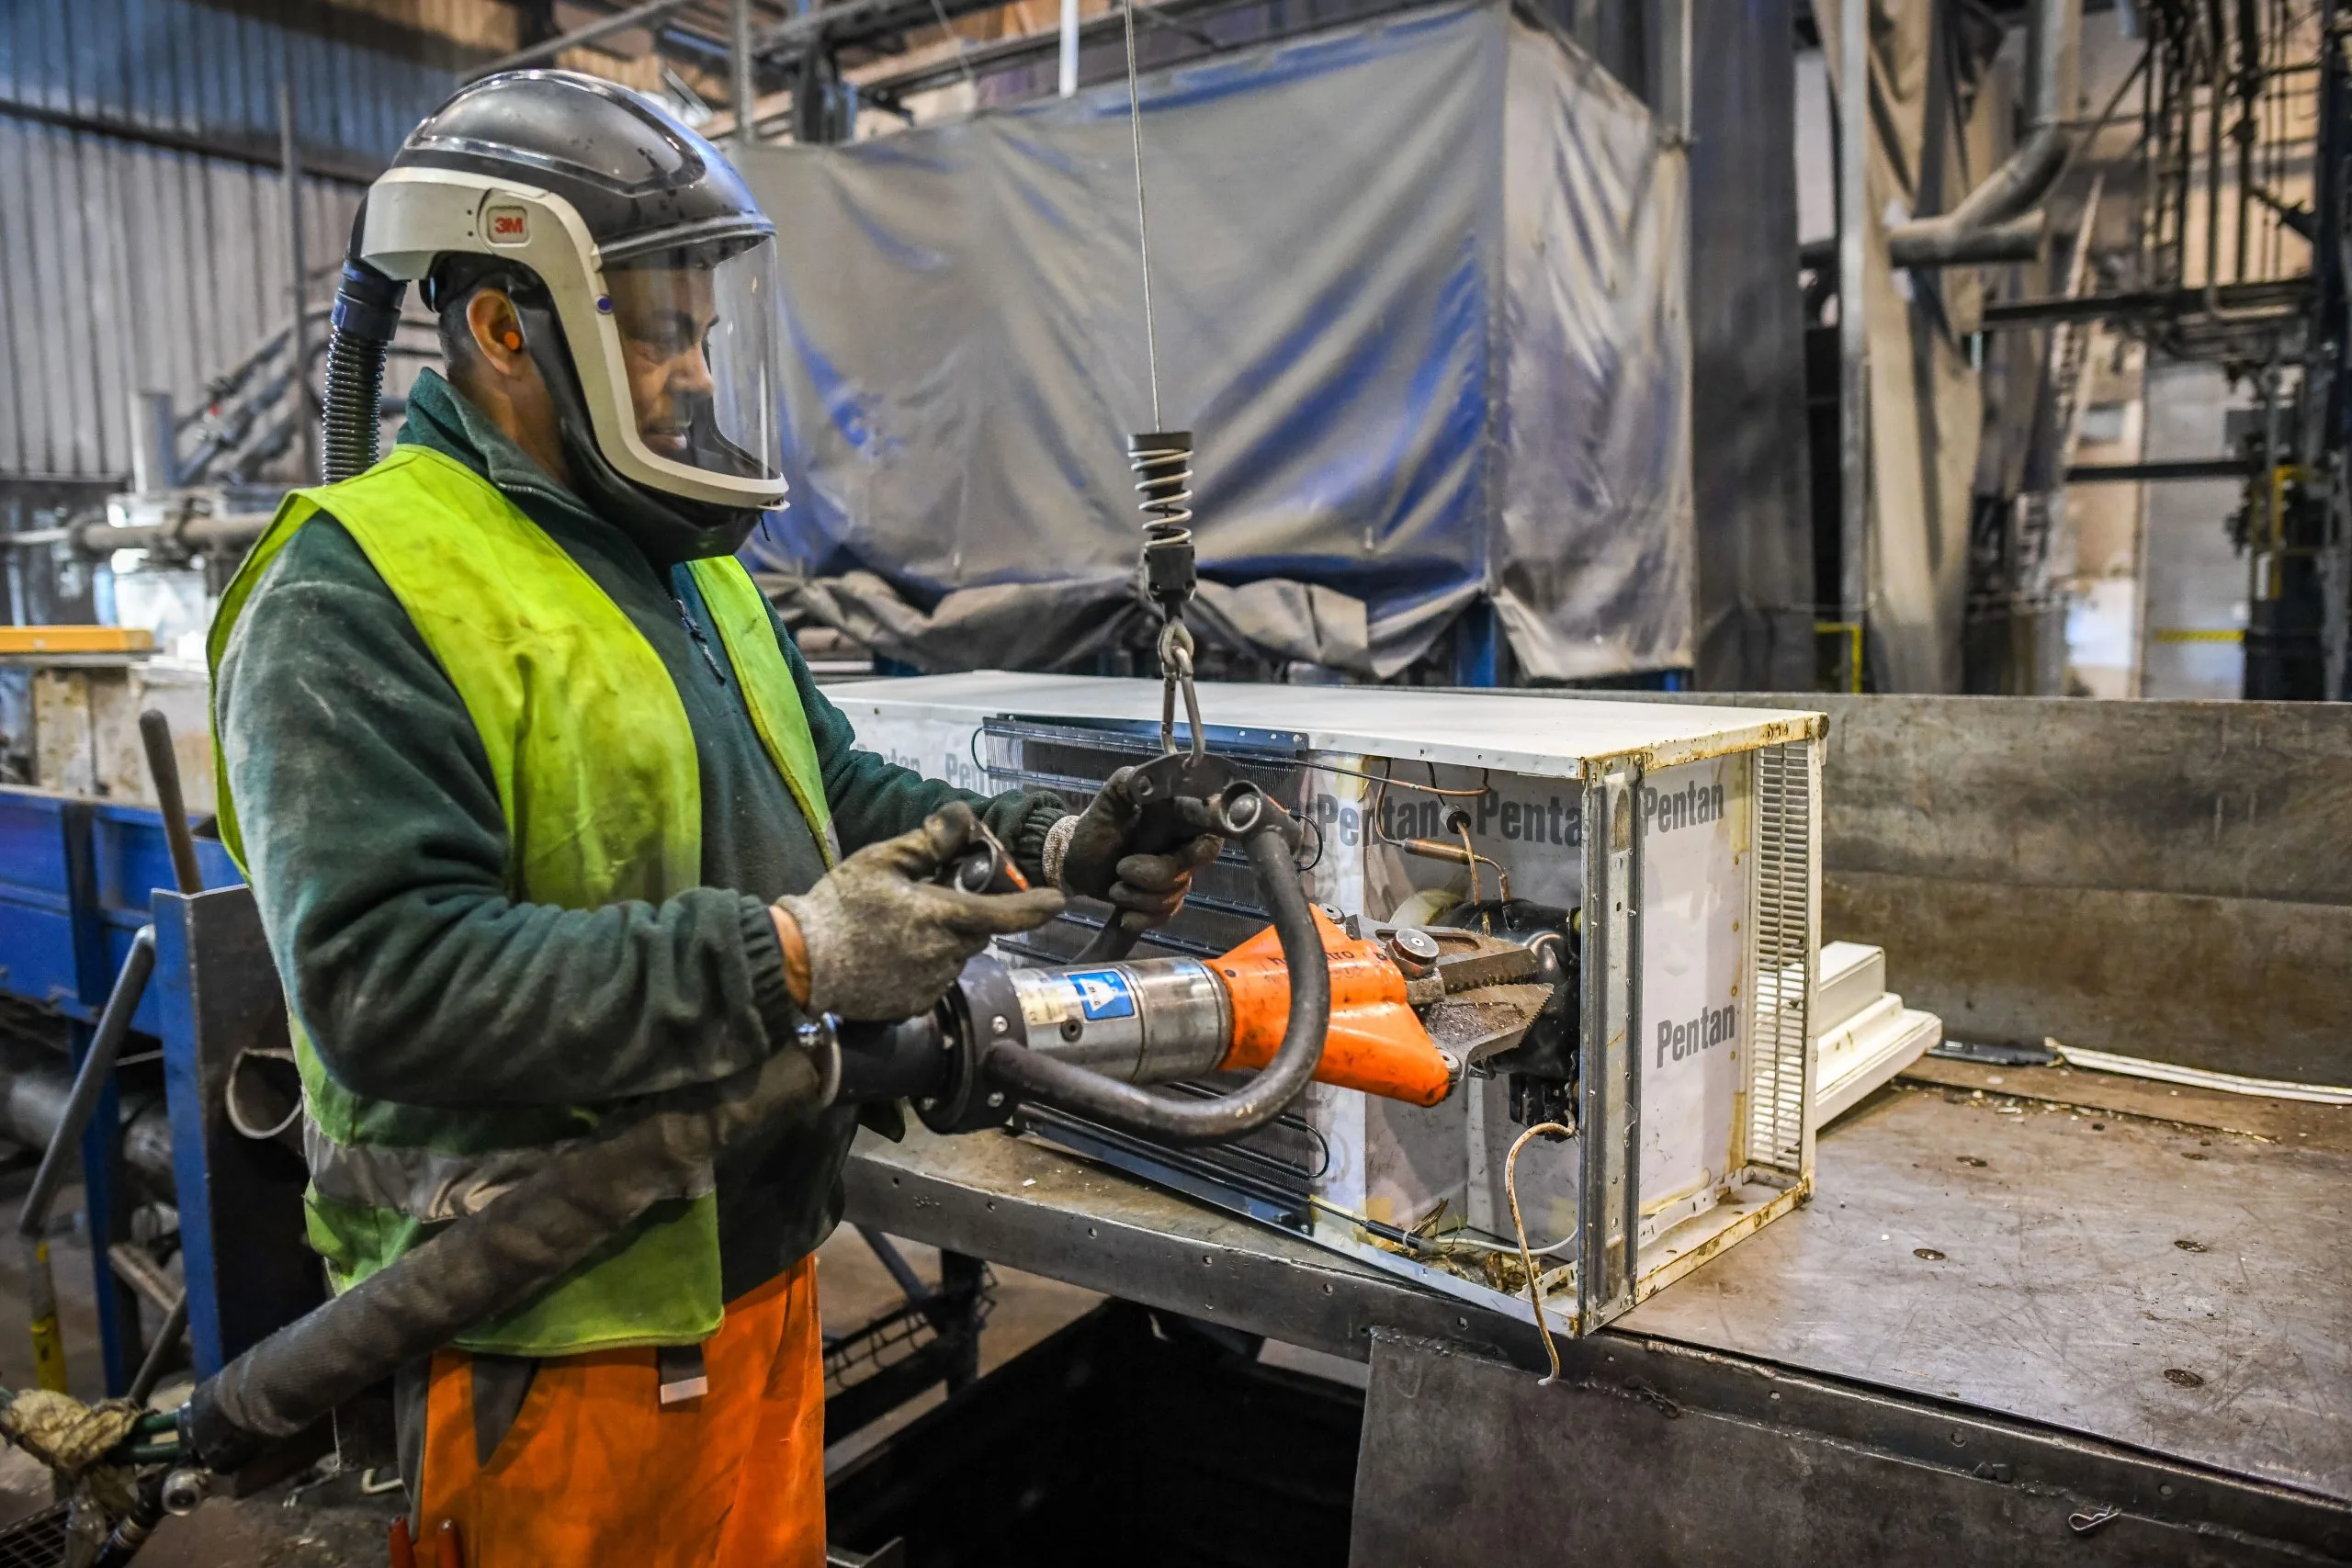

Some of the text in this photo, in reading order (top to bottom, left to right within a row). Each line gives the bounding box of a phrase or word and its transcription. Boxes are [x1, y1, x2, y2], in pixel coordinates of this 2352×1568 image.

[494, 217, 524, 234] 3M
[944, 752, 986, 795] Pen
[1317, 793, 1439, 848] Pentan
[1476, 788, 1583, 848] Penta
[1643, 780, 1724, 837] Pentan
[1657, 1004, 1736, 1069] Pentan
